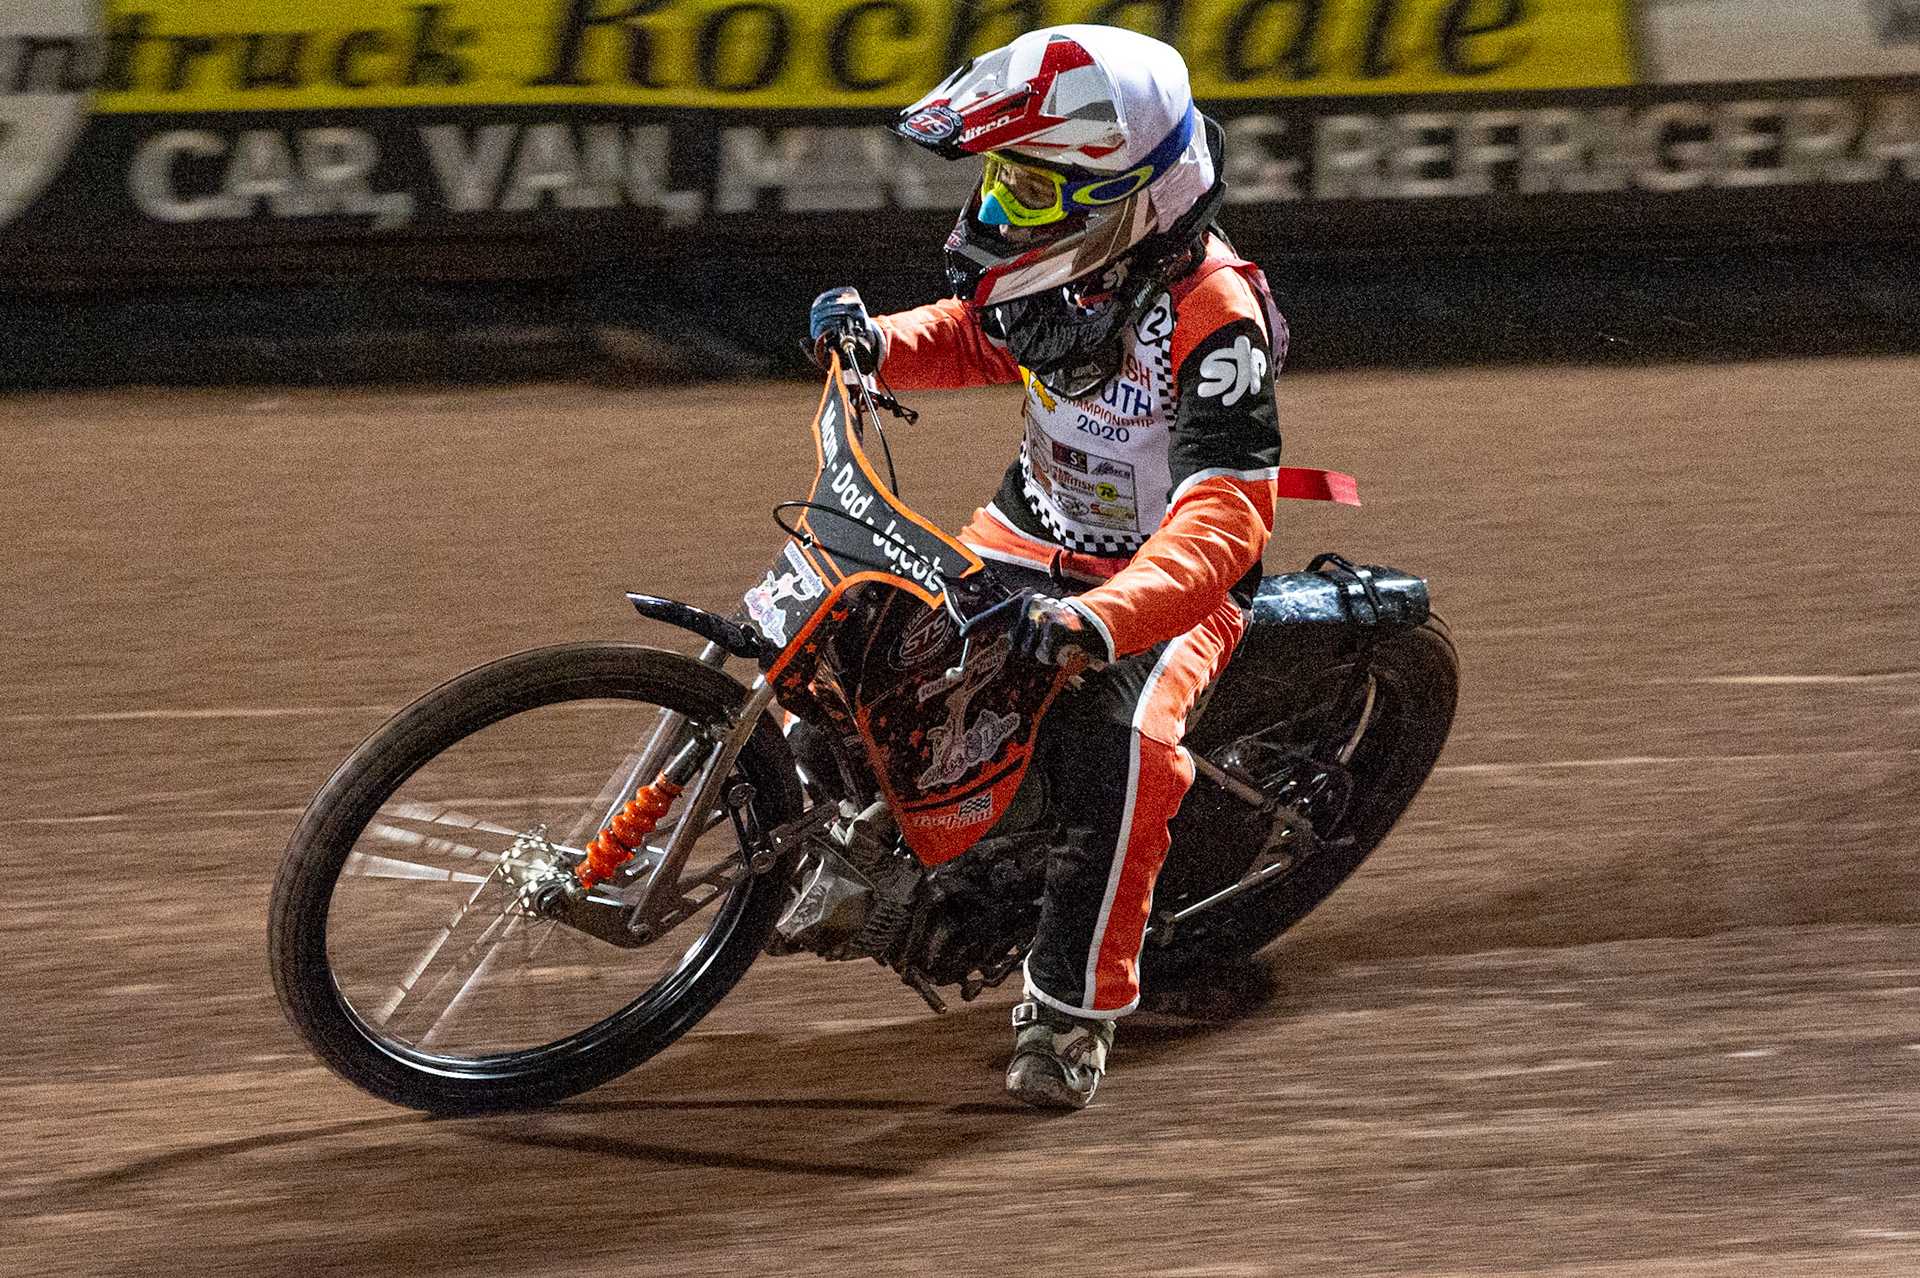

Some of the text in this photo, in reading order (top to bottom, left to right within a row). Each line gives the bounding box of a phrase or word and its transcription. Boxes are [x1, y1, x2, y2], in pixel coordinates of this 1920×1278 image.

[522, 0, 1530, 92] Rocale
[1147, 306, 1167, 337] 2
[1101, 379, 1152, 417] UTH
[1077, 414, 1130, 443] 2020
[831, 462, 874, 519] Dad
[872, 519, 945, 592] Jacob
